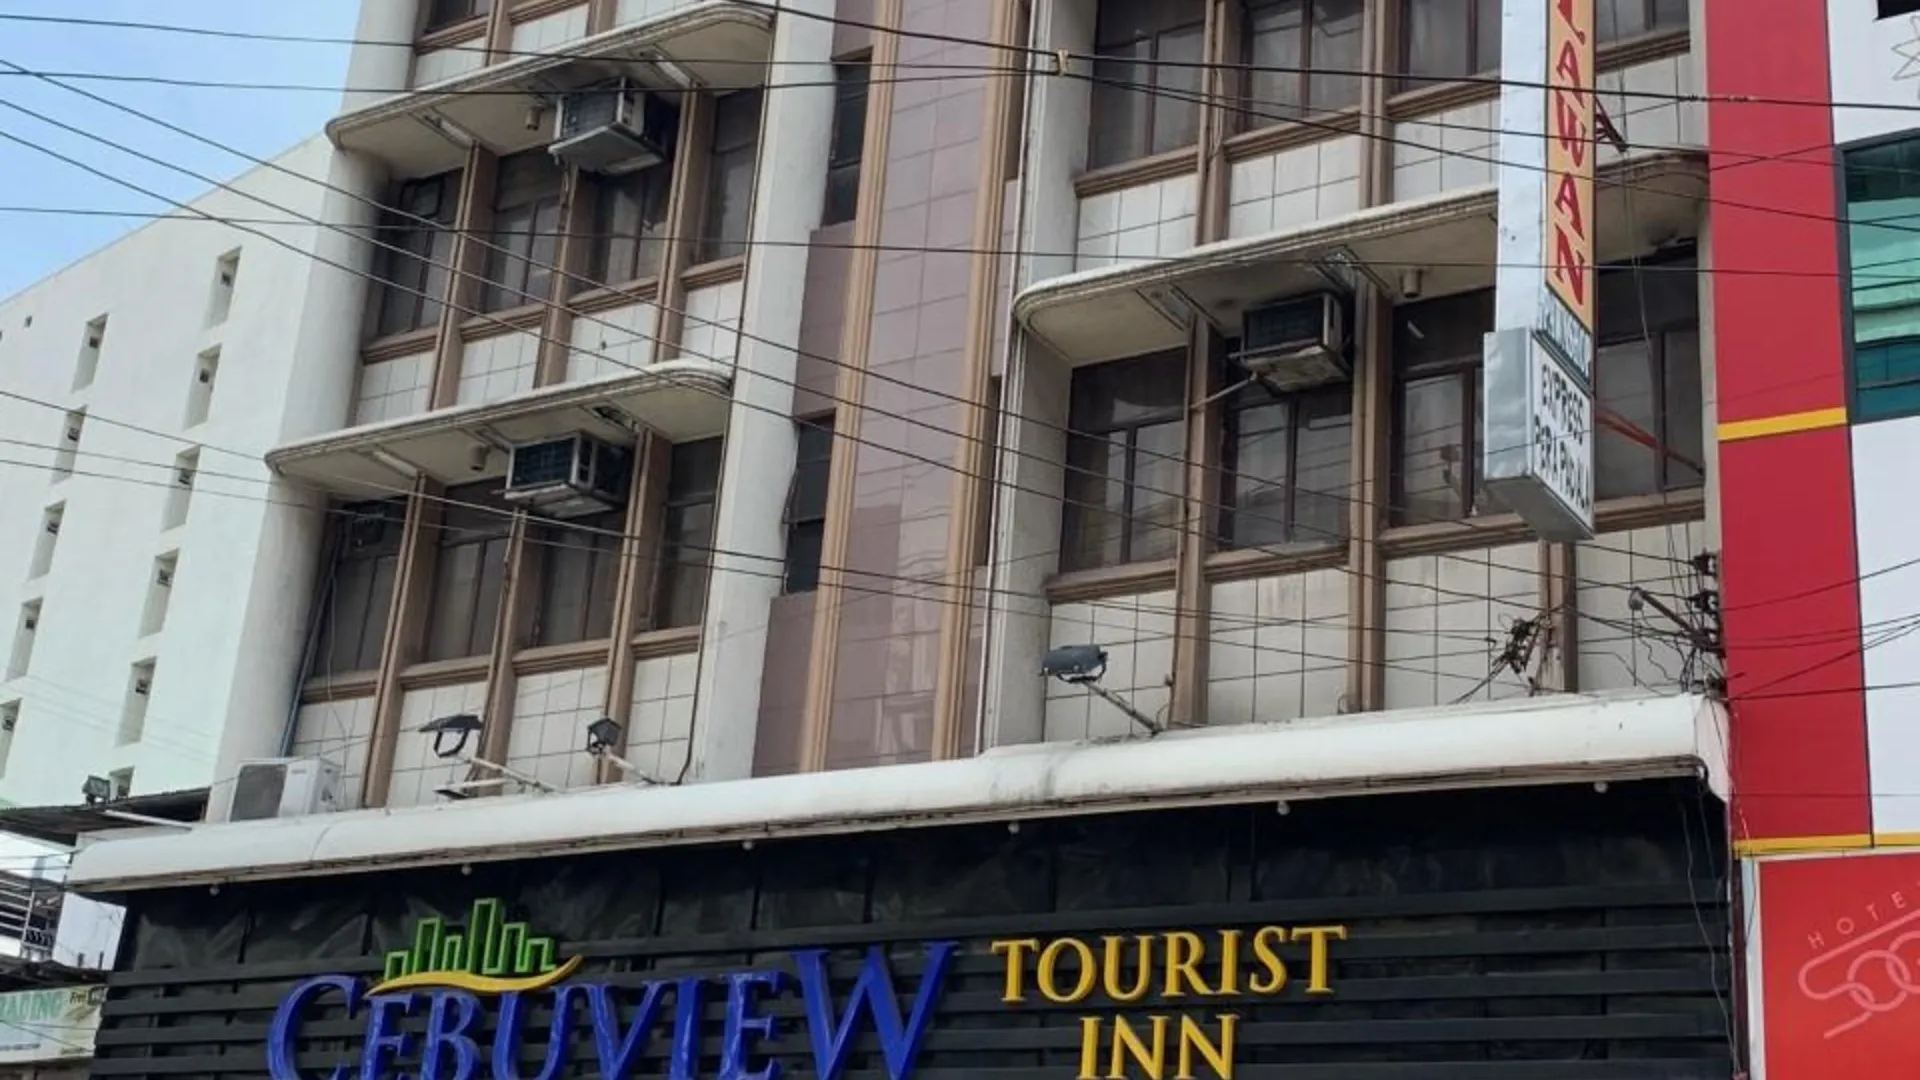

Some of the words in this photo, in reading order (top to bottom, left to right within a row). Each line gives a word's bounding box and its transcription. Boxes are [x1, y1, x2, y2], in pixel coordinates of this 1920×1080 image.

[1807, 879, 1920, 949] HOTE
[991, 924, 1347, 1003] TOURIST
[266, 940, 964, 1080] CEBUVIEW
[1075, 1013, 1241, 1080] INN
